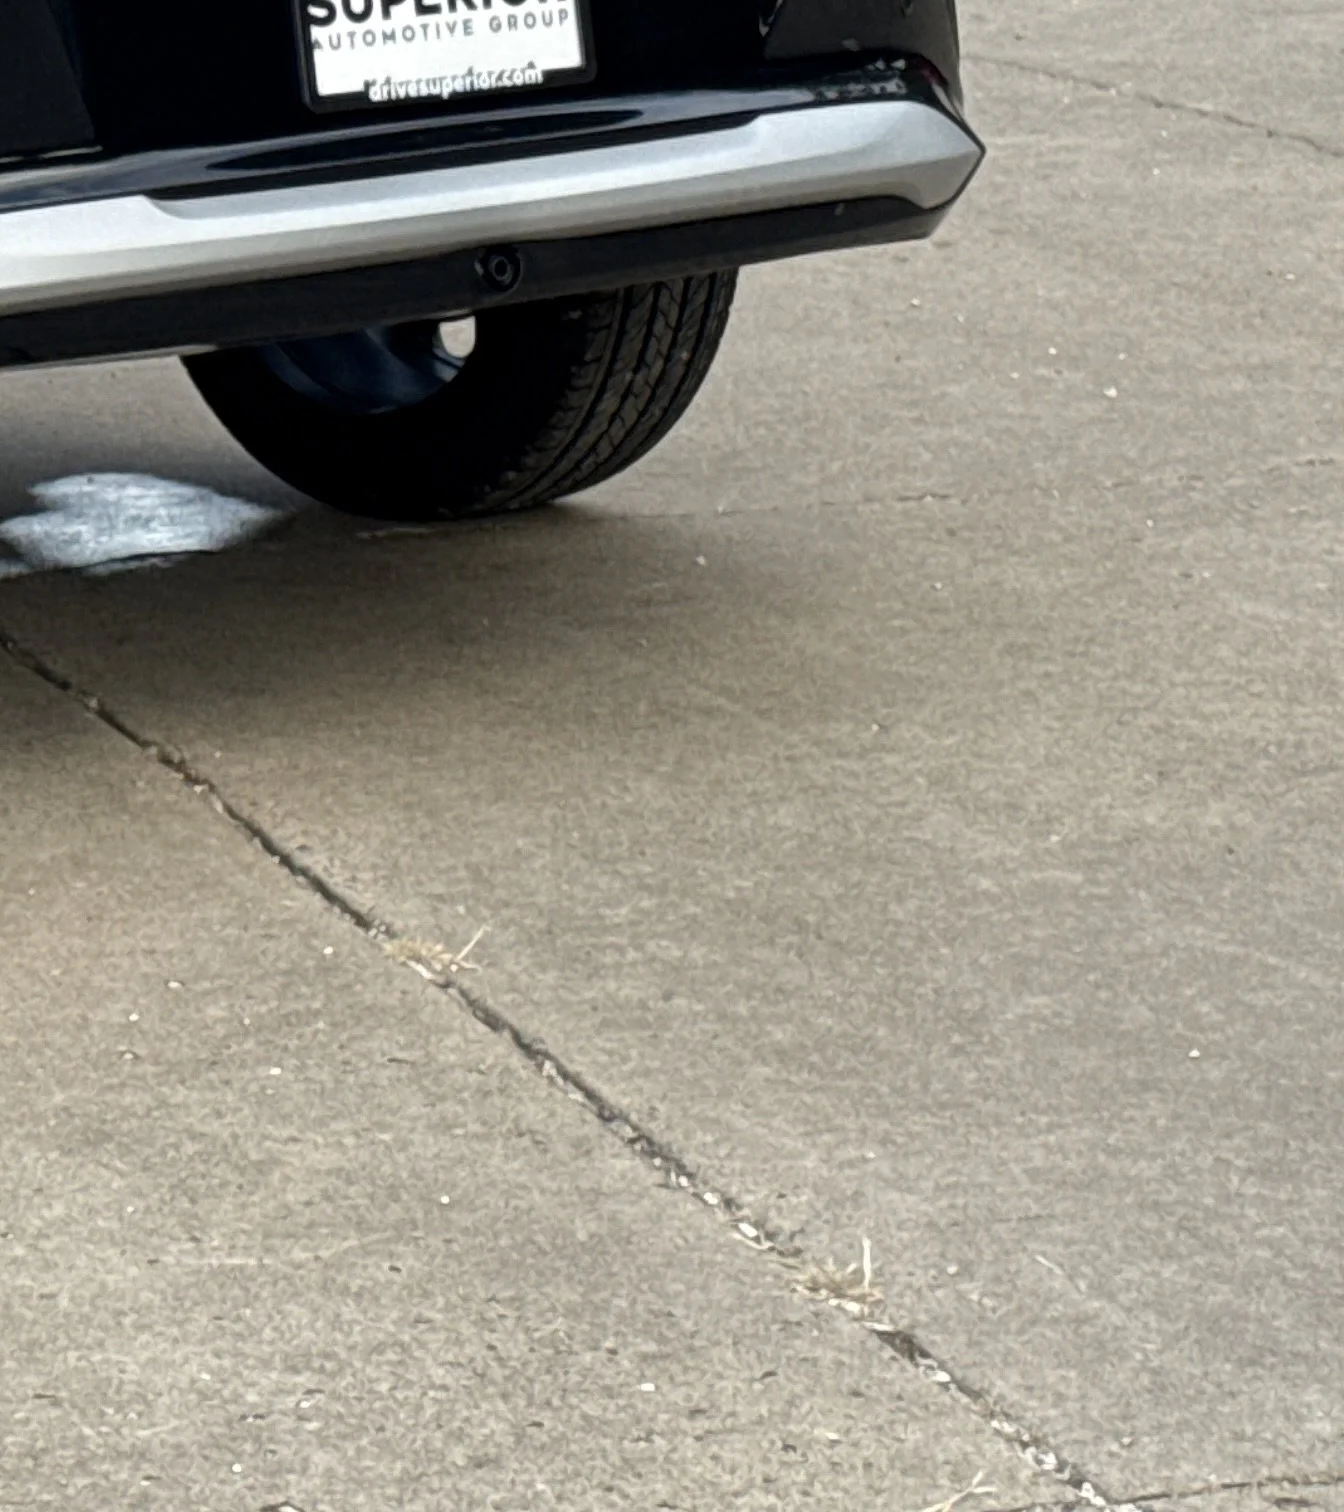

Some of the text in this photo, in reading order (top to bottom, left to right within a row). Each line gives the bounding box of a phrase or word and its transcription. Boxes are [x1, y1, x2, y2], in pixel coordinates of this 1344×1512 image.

[312, 8, 569, 51] AUTOMOTIVE GROUP
[365, 63, 544, 102] drivesuperior.com
